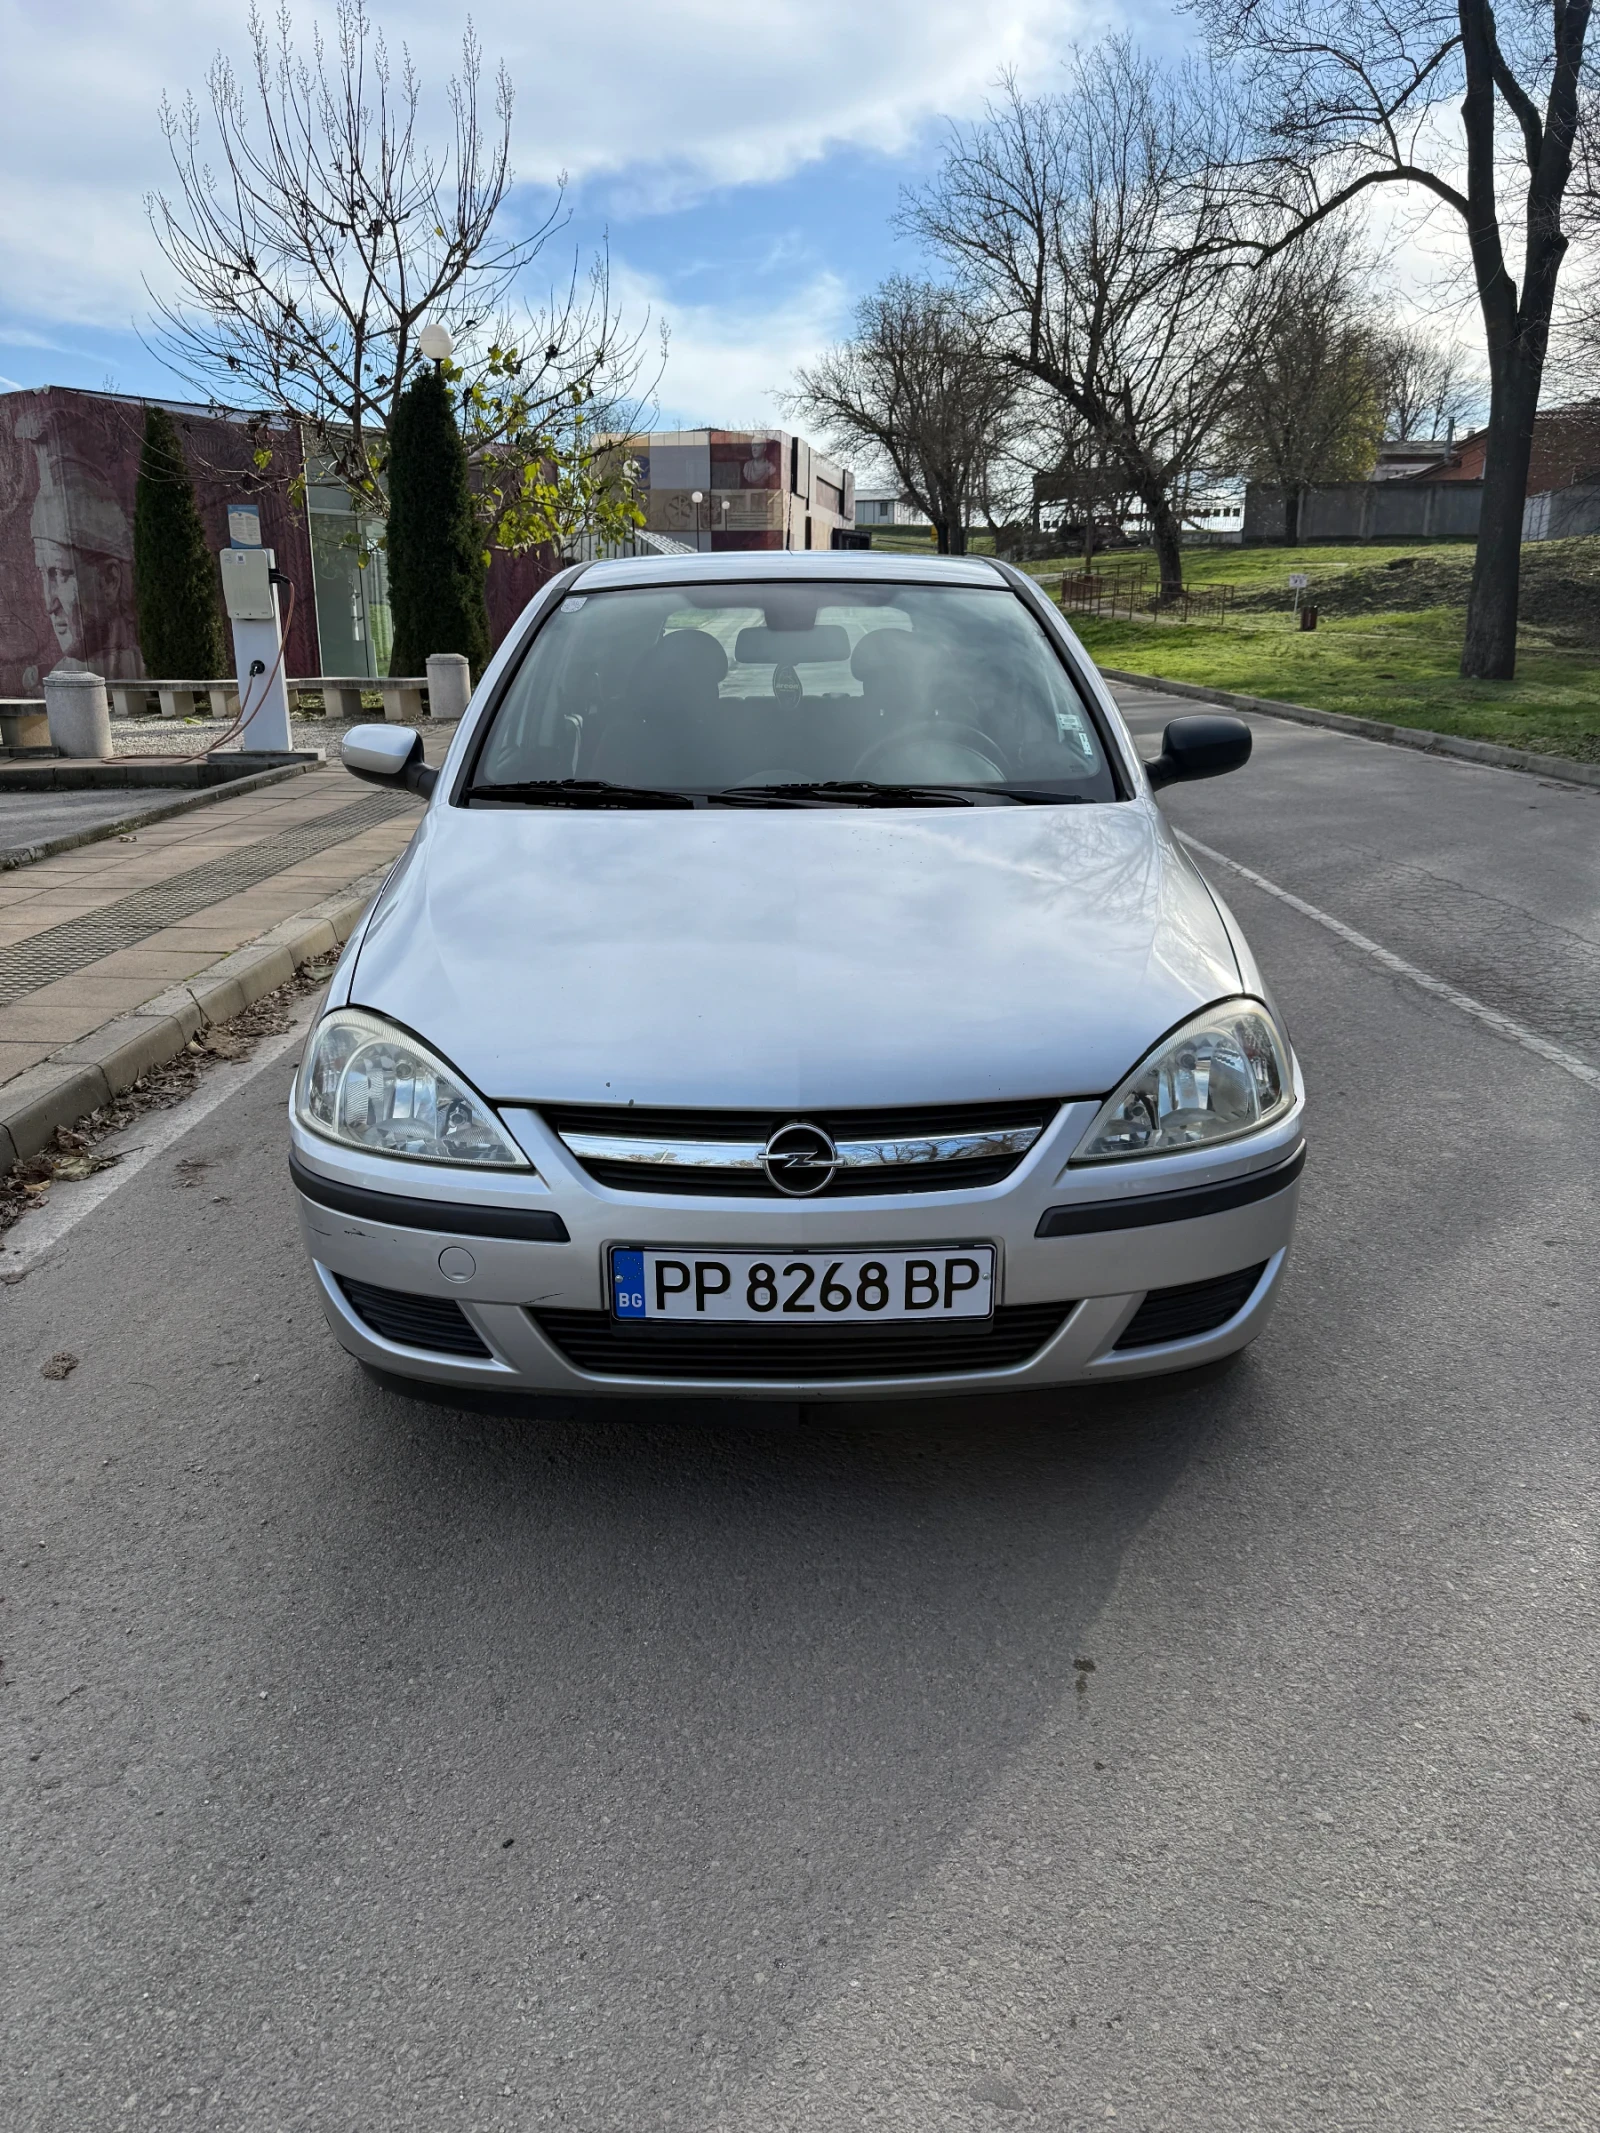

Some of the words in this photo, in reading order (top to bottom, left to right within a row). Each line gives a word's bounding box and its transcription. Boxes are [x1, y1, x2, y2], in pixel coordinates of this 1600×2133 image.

[618, 1292, 643, 1308] BG
[655, 1260, 731, 1311] PP
[746, 1261, 889, 1312] 8268
[904, 1258, 980, 1310] BP
